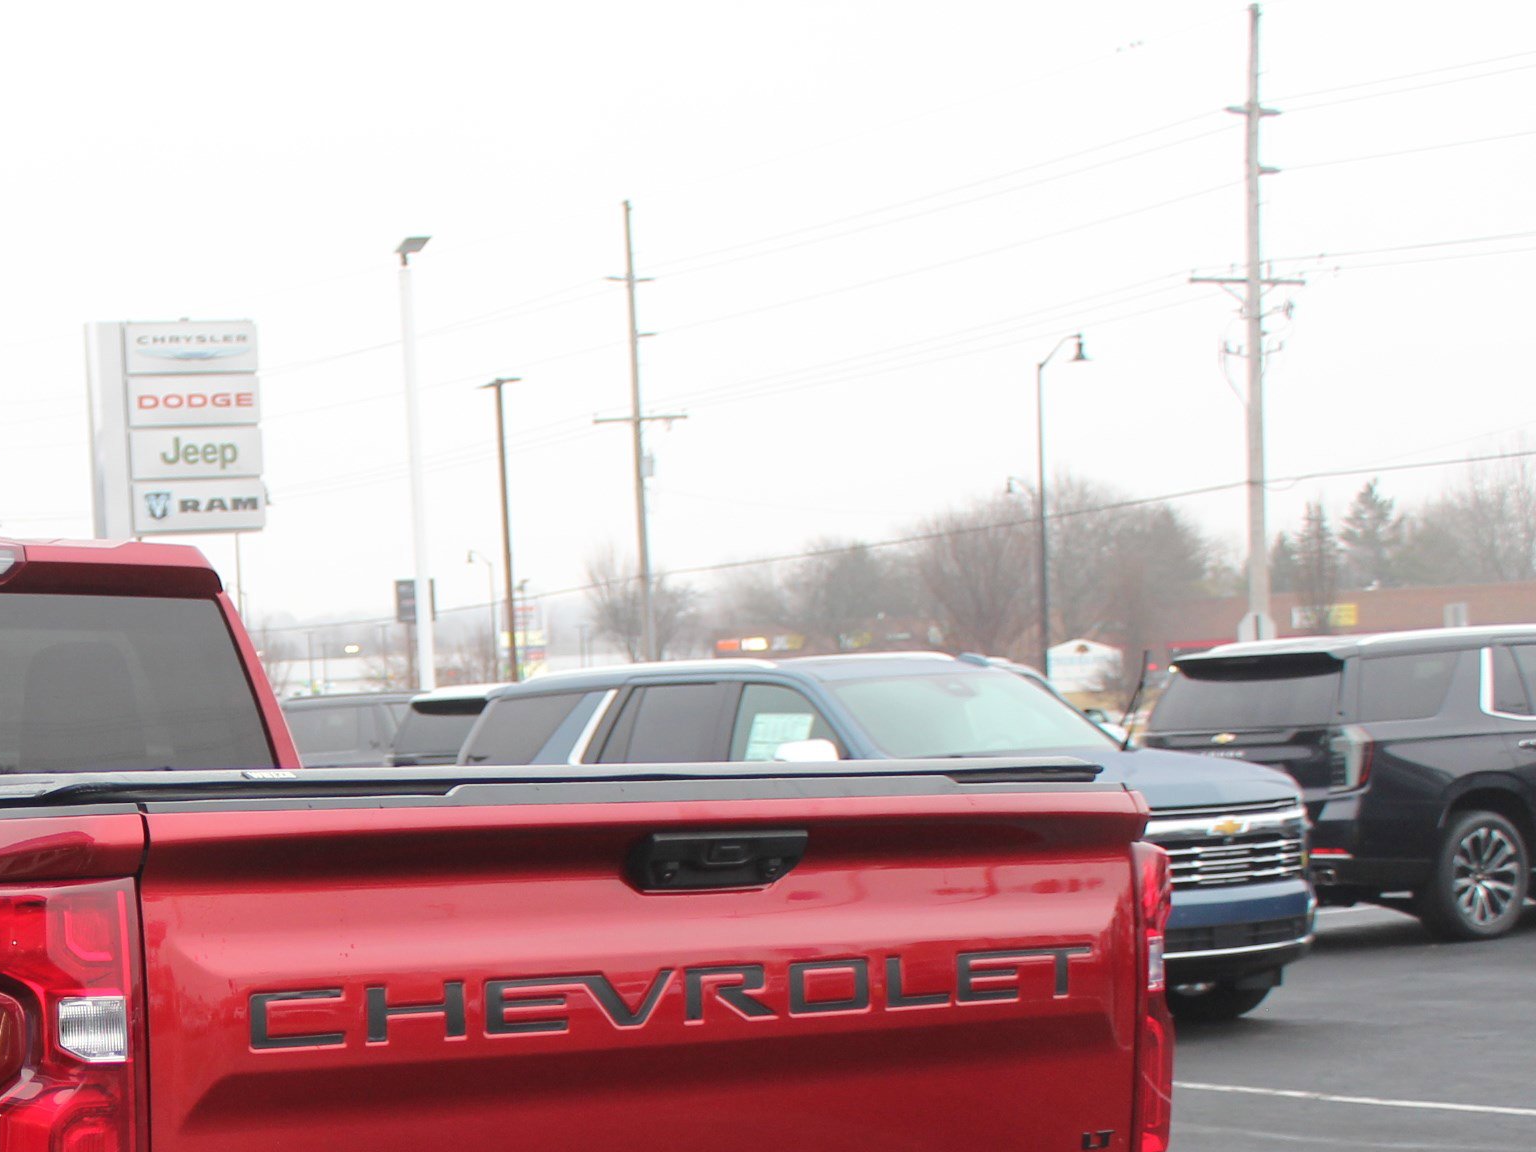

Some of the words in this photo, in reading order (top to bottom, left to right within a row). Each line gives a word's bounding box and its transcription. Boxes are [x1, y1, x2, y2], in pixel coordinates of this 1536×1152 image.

[136, 334, 248, 345] CHRYSLER
[137, 393, 254, 410] DODGE
[160, 437, 238, 469] Jeep
[178, 497, 259, 513] RAM
[249, 942, 1094, 1054] CHEVROLET
[1082, 1129, 1116, 1150] LT
